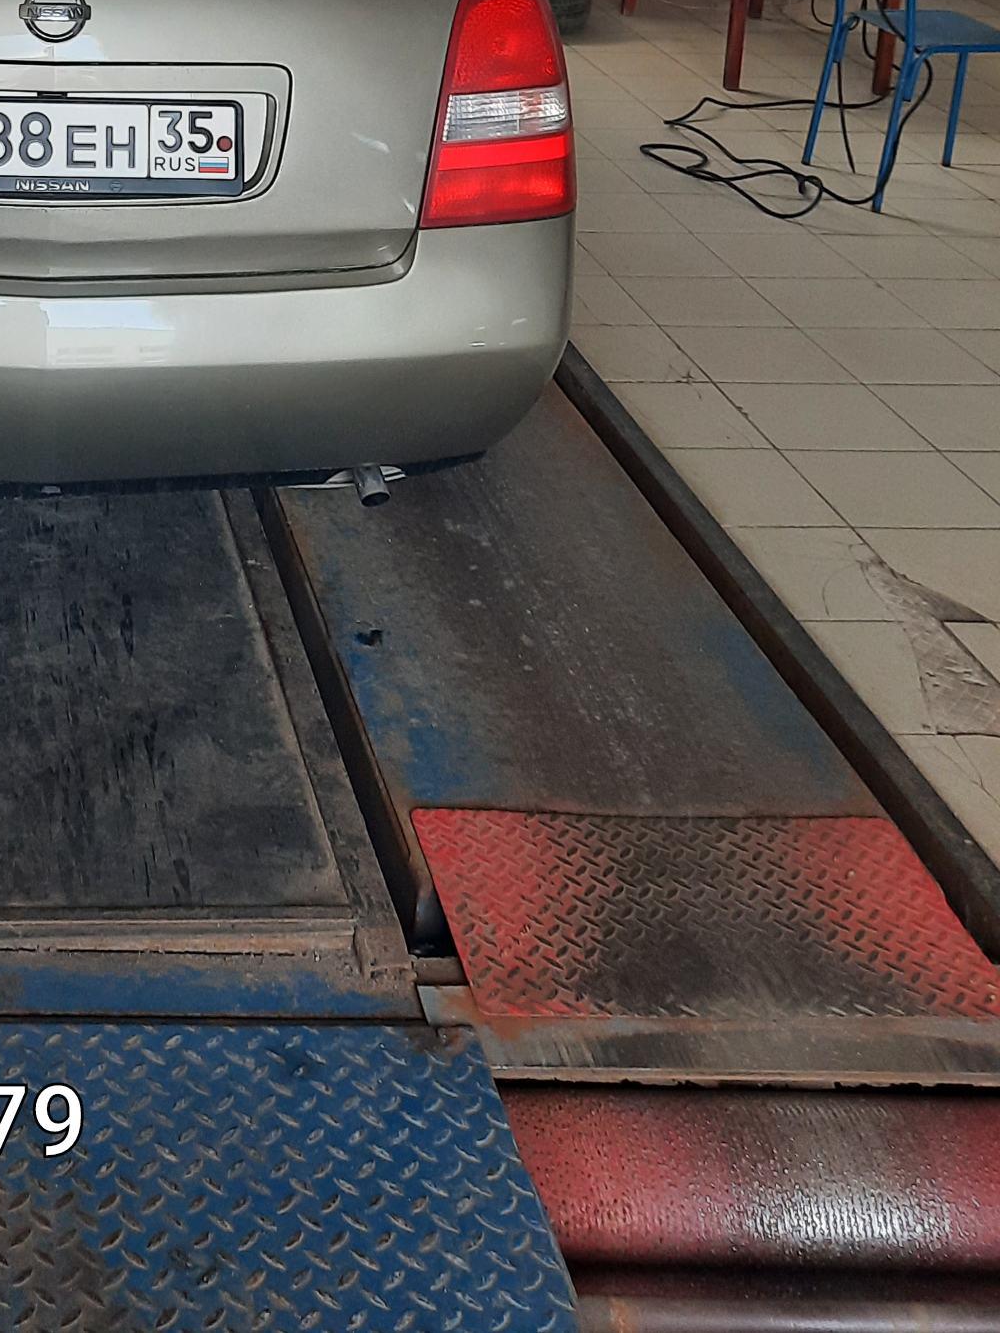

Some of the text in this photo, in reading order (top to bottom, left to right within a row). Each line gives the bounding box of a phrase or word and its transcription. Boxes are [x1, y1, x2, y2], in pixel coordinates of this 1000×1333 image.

[27, 5, 84, 19] NISSAN
[157, 110, 214, 154] 35
[154, 155, 196, 173] RUS
[15, 179, 90, 192] NISSAN
